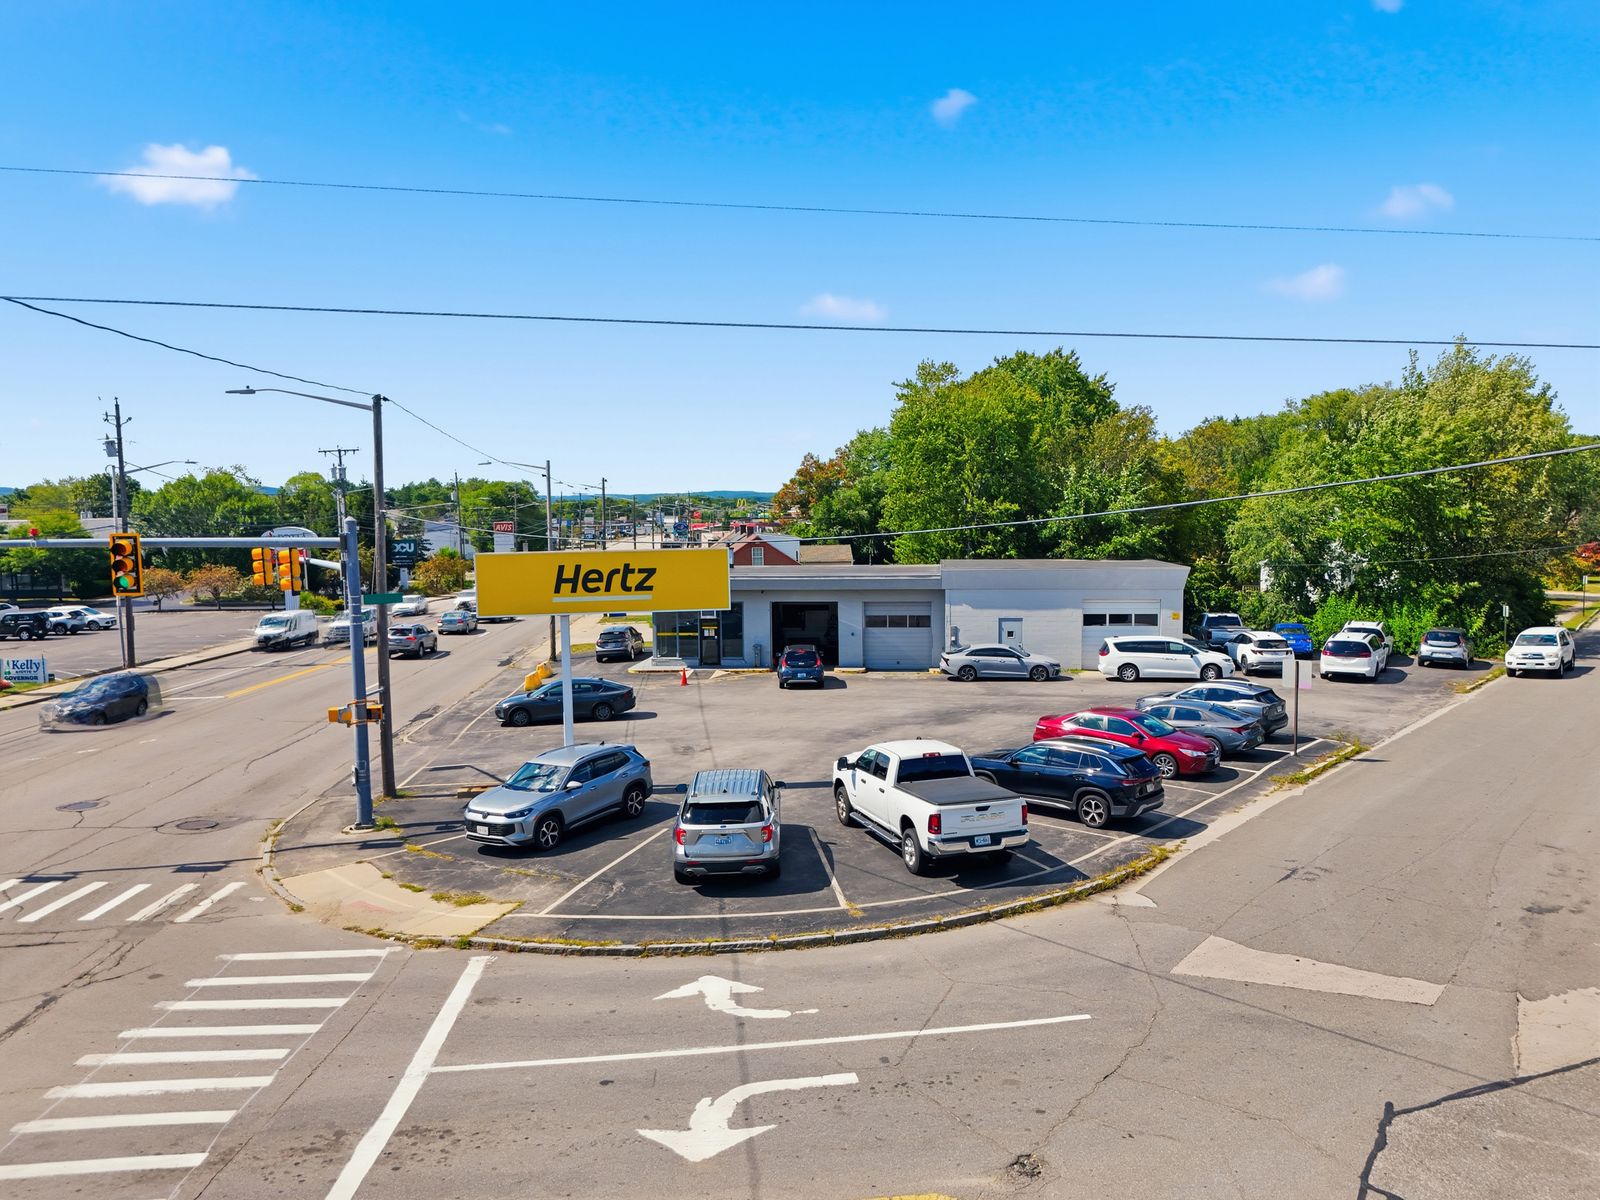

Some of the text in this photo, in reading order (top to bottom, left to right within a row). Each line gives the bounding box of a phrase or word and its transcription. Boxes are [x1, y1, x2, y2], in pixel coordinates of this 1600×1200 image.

[496, 524, 512, 532] AVIS
[554, 563, 657, 594] Hertz
[12, 660, 40, 673] Kelly
